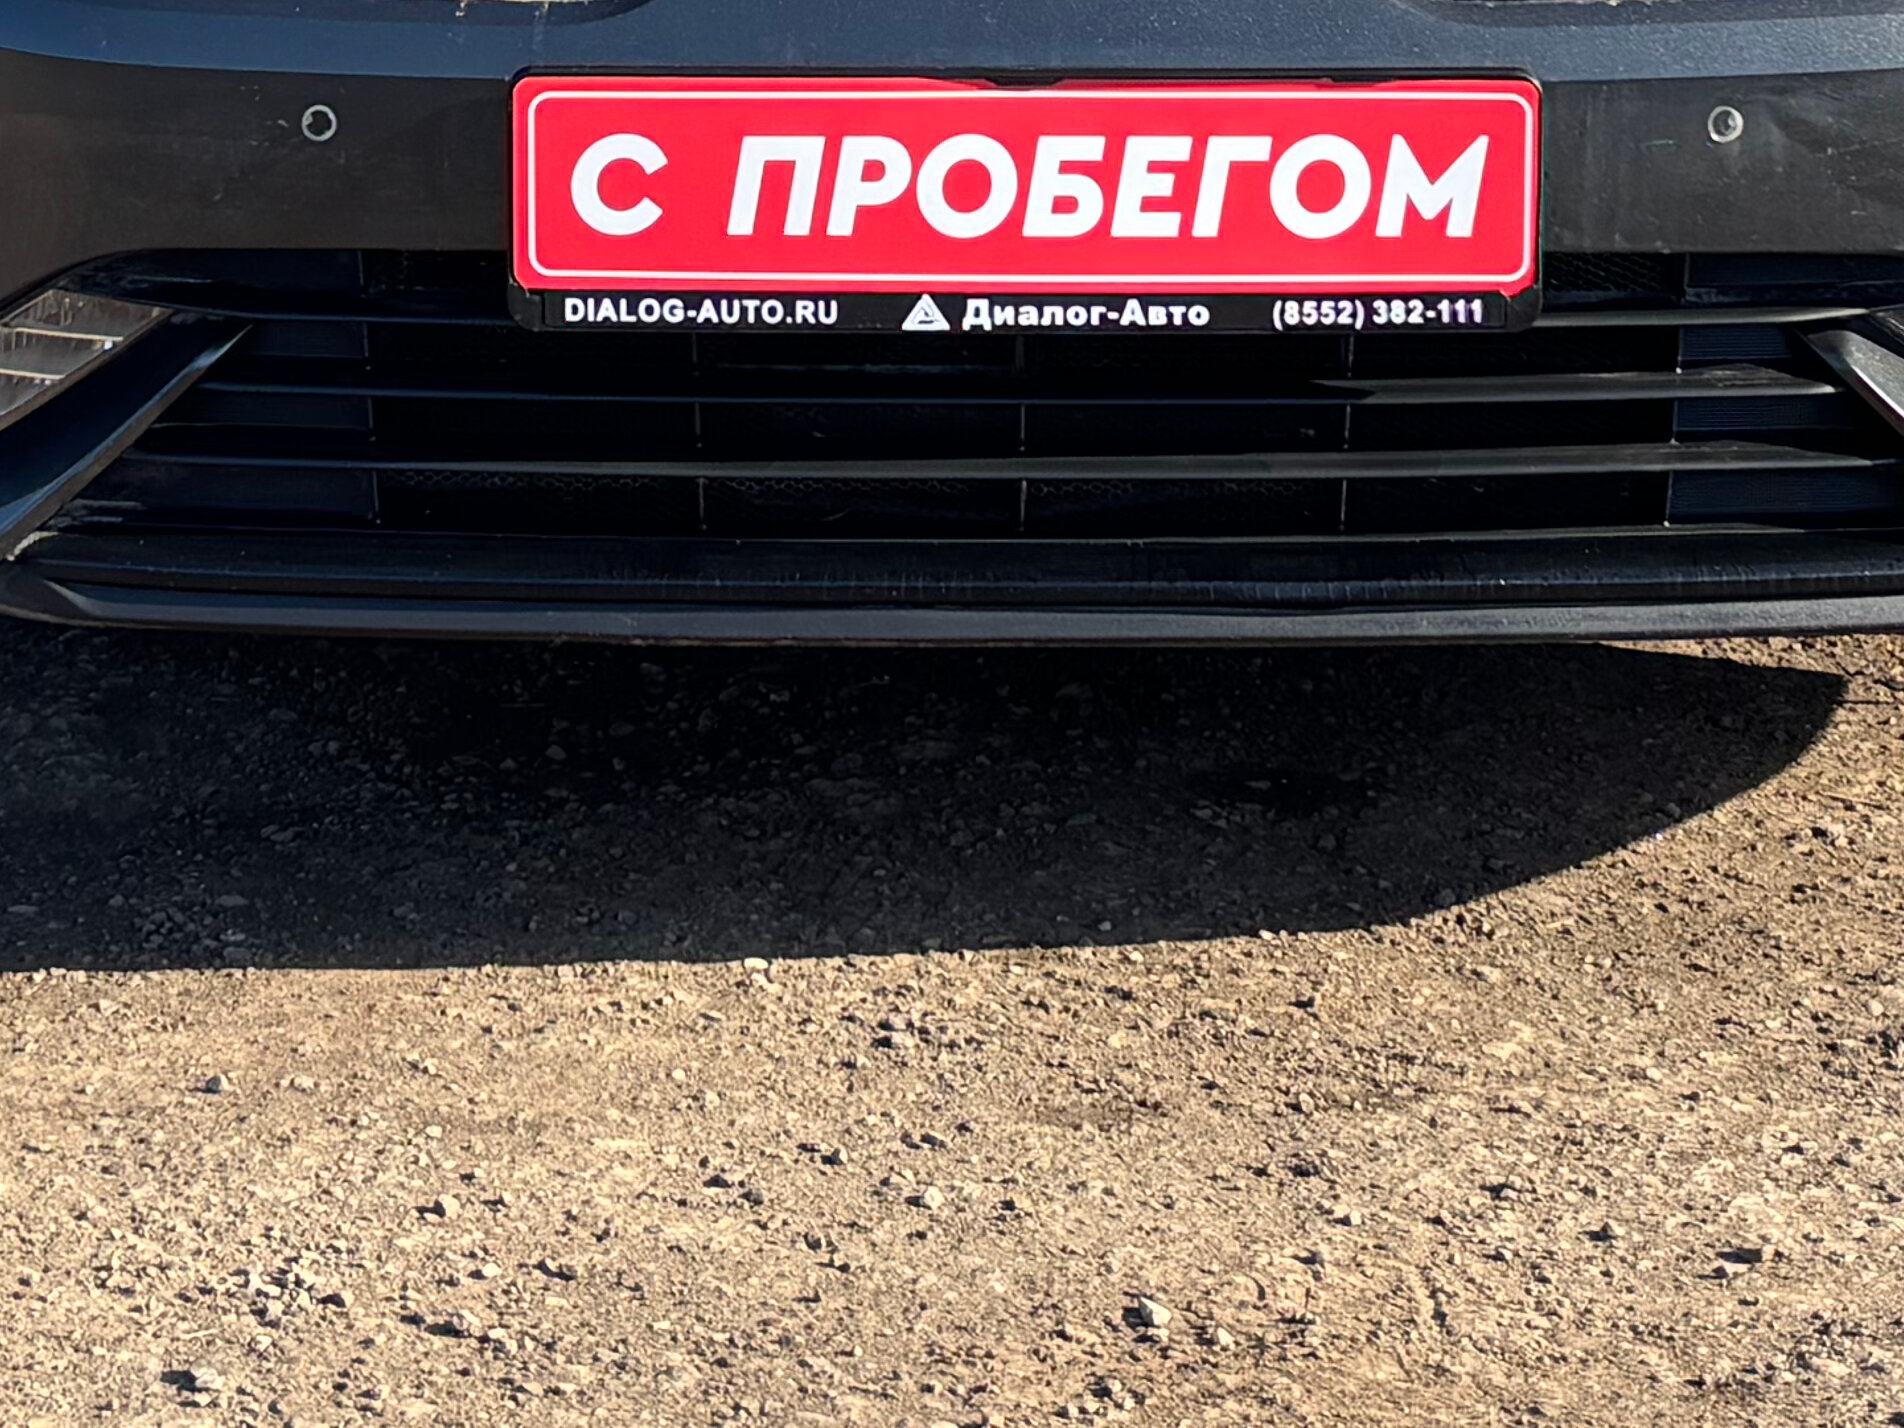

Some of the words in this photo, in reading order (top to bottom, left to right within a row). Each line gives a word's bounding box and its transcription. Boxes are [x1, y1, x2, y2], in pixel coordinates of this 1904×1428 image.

[570, 132, 669, 237] С
[727, 132, 1489, 239] ПРОБЕГОМ
[564, 297, 839, 326] DIALOG-AUTO.RU
[961, 298, 1210, 332] Диалог-Авто
[1272, 299, 1365, 331] (8552)
[1372, 298, 1484, 325] 382-111
